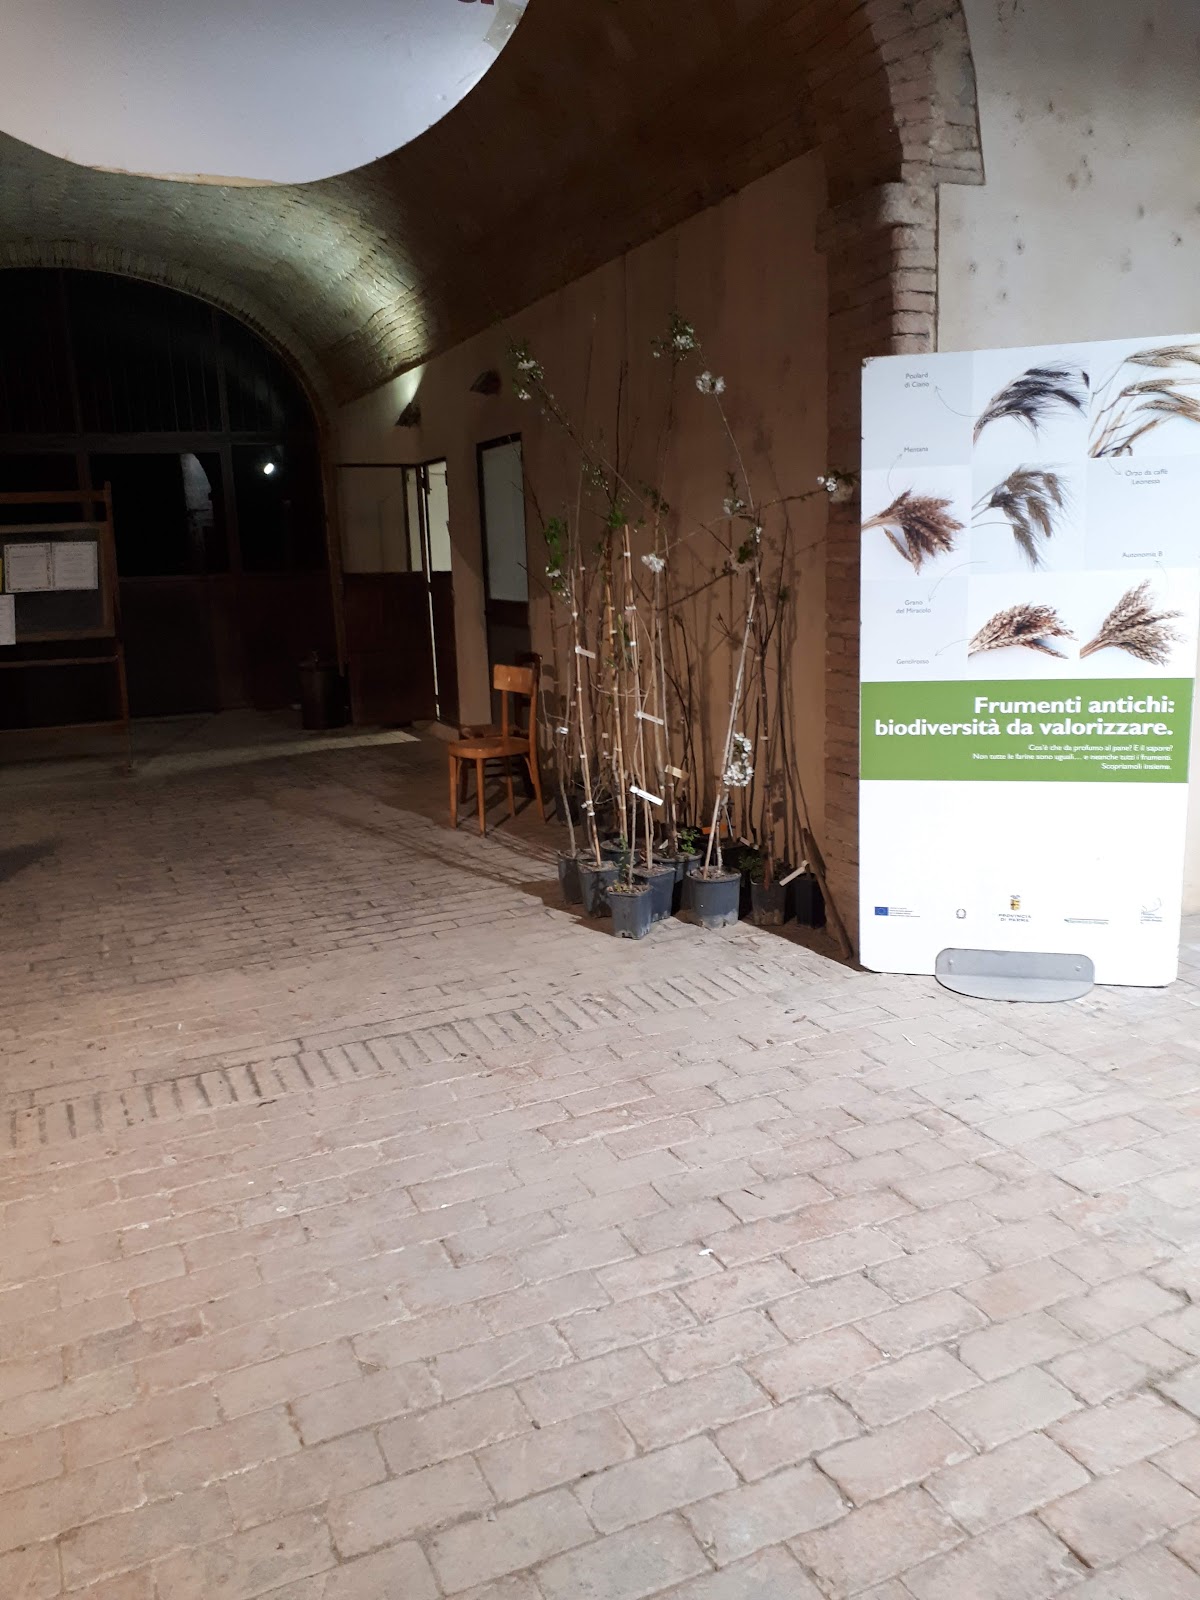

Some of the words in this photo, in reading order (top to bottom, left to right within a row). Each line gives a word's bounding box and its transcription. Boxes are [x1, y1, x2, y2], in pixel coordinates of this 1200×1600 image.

[974, 696, 1082, 714] Frumenti
[1088, 695, 1175, 714] antichi:
[875, 719, 1001, 736] biodiversità
[1006, 719, 1034, 736] da
[1039, 718, 1174, 736] valorizzare.
[1073, 744, 1104, 752] profumo
[1101, 763, 1143, 771] Scopriamoli
